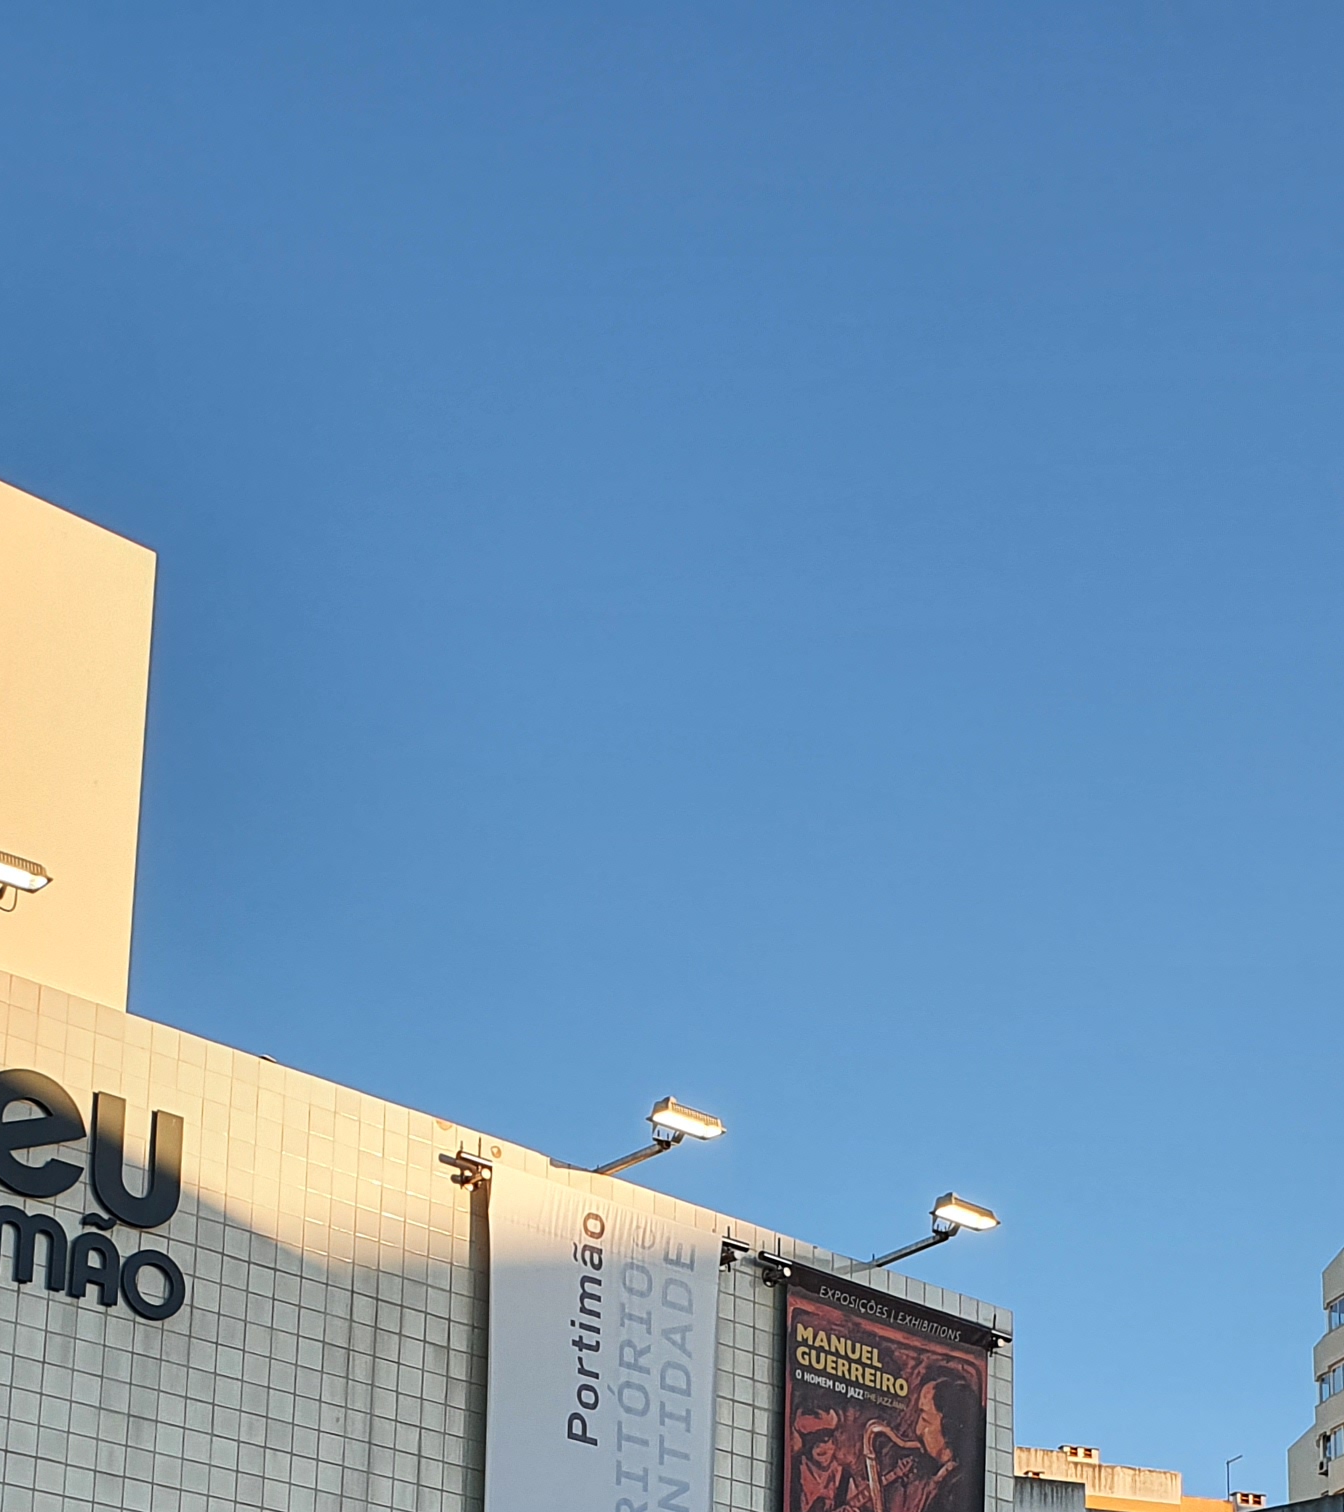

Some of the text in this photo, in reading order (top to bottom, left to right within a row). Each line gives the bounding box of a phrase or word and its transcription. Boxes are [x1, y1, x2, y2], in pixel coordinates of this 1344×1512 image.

[567, 1212, 606, 1447] Portimão
[819, 1285, 888, 1319] EXPOSIÇÕES
[897, 1311, 962, 1342] EXHIBITIONS
[796, 1323, 883, 1368] MANUEL
[795, 1346, 909, 1397] GUERREIRO
[795, 1369, 802, 1380] O
[804, 1372, 833, 1389] HOMEM
[835, 1381, 846, 1394] DO
[847, 1386, 864, 1400] JAZZ
